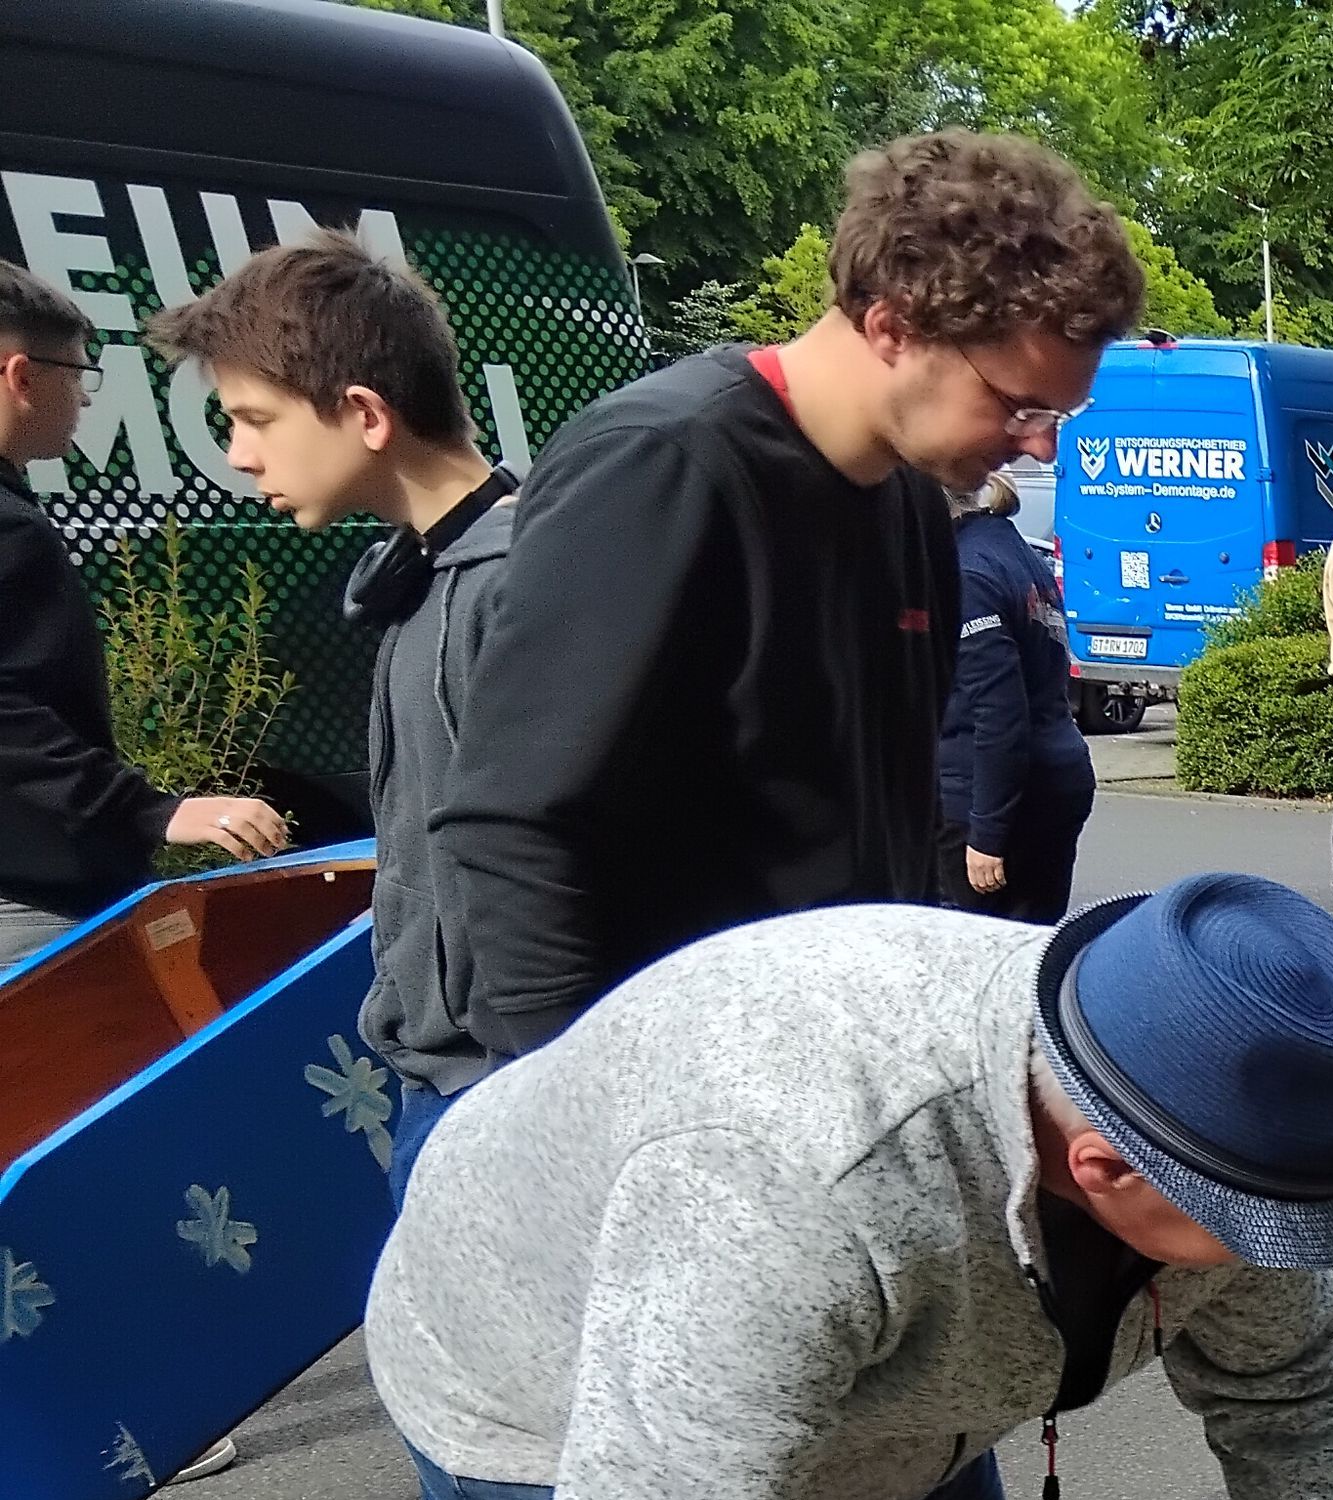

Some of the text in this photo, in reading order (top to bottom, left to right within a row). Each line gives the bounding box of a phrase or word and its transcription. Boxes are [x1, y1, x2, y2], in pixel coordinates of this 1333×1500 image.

[1114, 437, 1247, 451] ENTSORGUNGSFACHBETRIEB
[1115, 448, 1246, 480] WERNER
[1123, 641, 1146, 654] 1702
